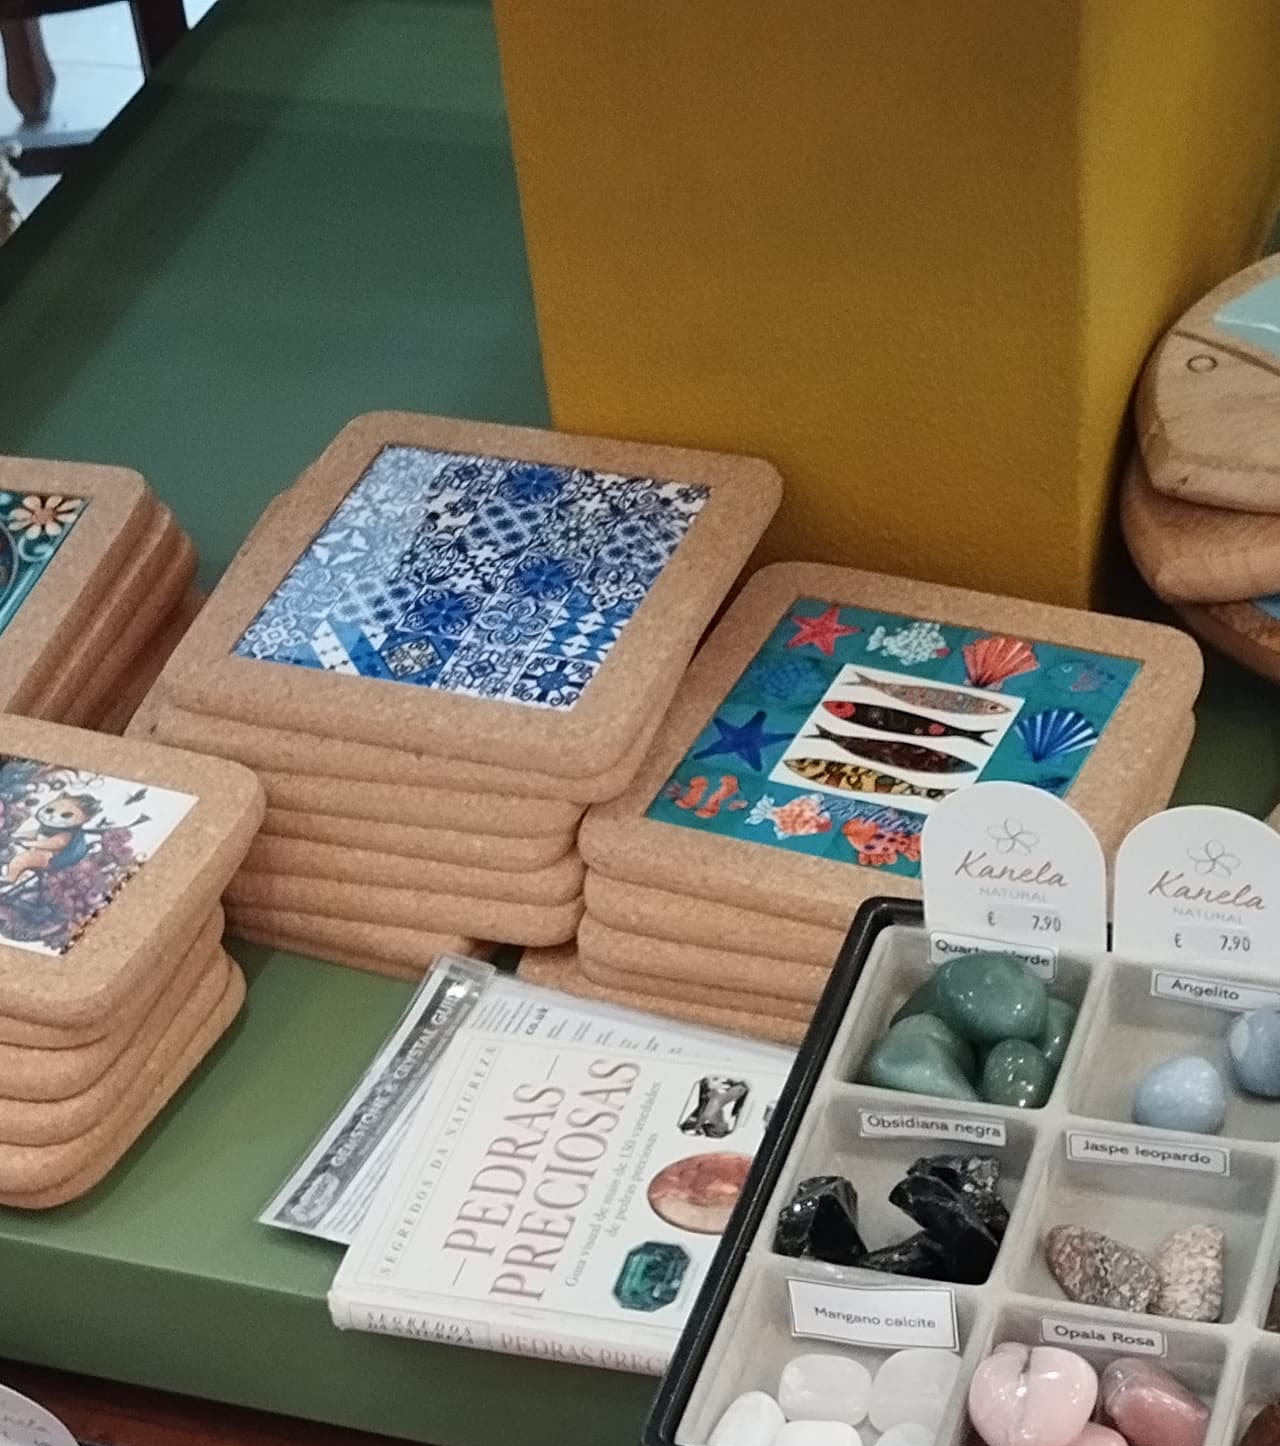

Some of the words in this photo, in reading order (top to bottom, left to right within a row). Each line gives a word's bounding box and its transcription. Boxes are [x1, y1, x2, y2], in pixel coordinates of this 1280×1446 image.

[954, 849, 1068, 888] Kanela
[1149, 870, 1265, 910] Kanela
[1171, 978, 1239, 1001] Angelito
[867, 1113, 950, 1132] Obsidiana
[954, 1121, 1002, 1139] negra
[380, 1177, 433, 1276] SEGREDOS
[433, 1147, 450, 1171] DA
[445, 1047, 498, 1140] NATUREZA
[1083, 1140, 1129, 1158] Jaspe
[1134, 1145, 1211, 1166] leopardo
[443, 1083, 565, 1256] PEDRAS
[489, 1058, 641, 1301] PRECIOSAS
[814, 1306, 881, 1326] Mangano
[885, 1315, 936, 1330] calcite
[1054, 1324, 1107, 1344] Opala
[1112, 1333, 1155, 1348] Rosa
